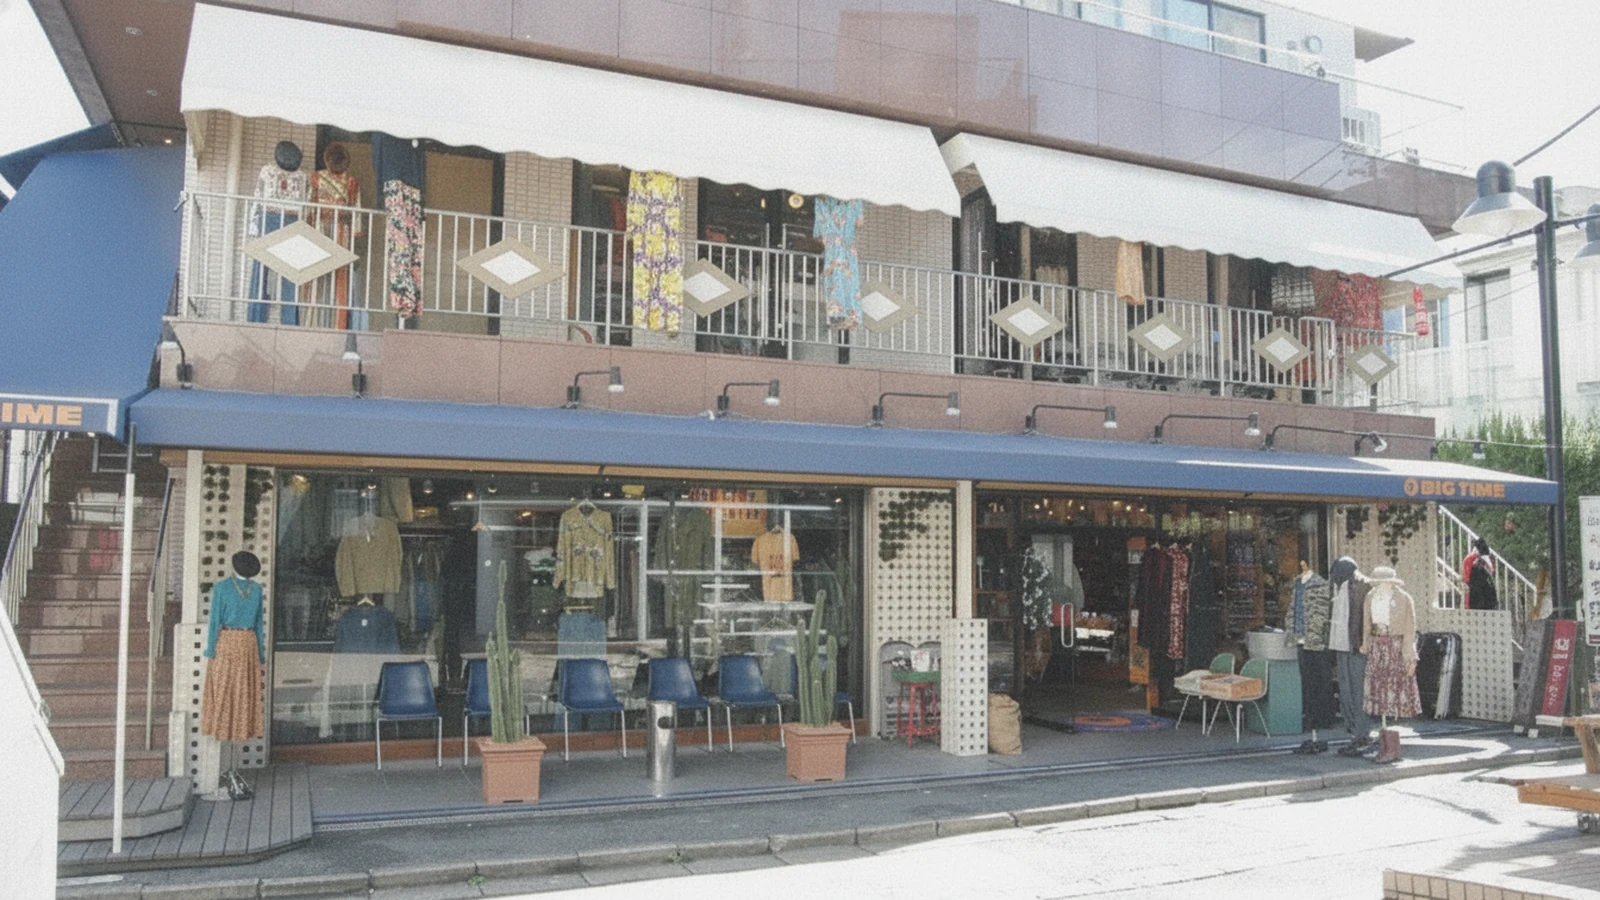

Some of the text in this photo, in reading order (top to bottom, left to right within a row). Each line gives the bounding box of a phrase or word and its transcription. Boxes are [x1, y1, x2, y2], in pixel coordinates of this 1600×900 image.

[2, 402, 82, 426] IME
[1420, 479, 1505, 498] BIG TIME
